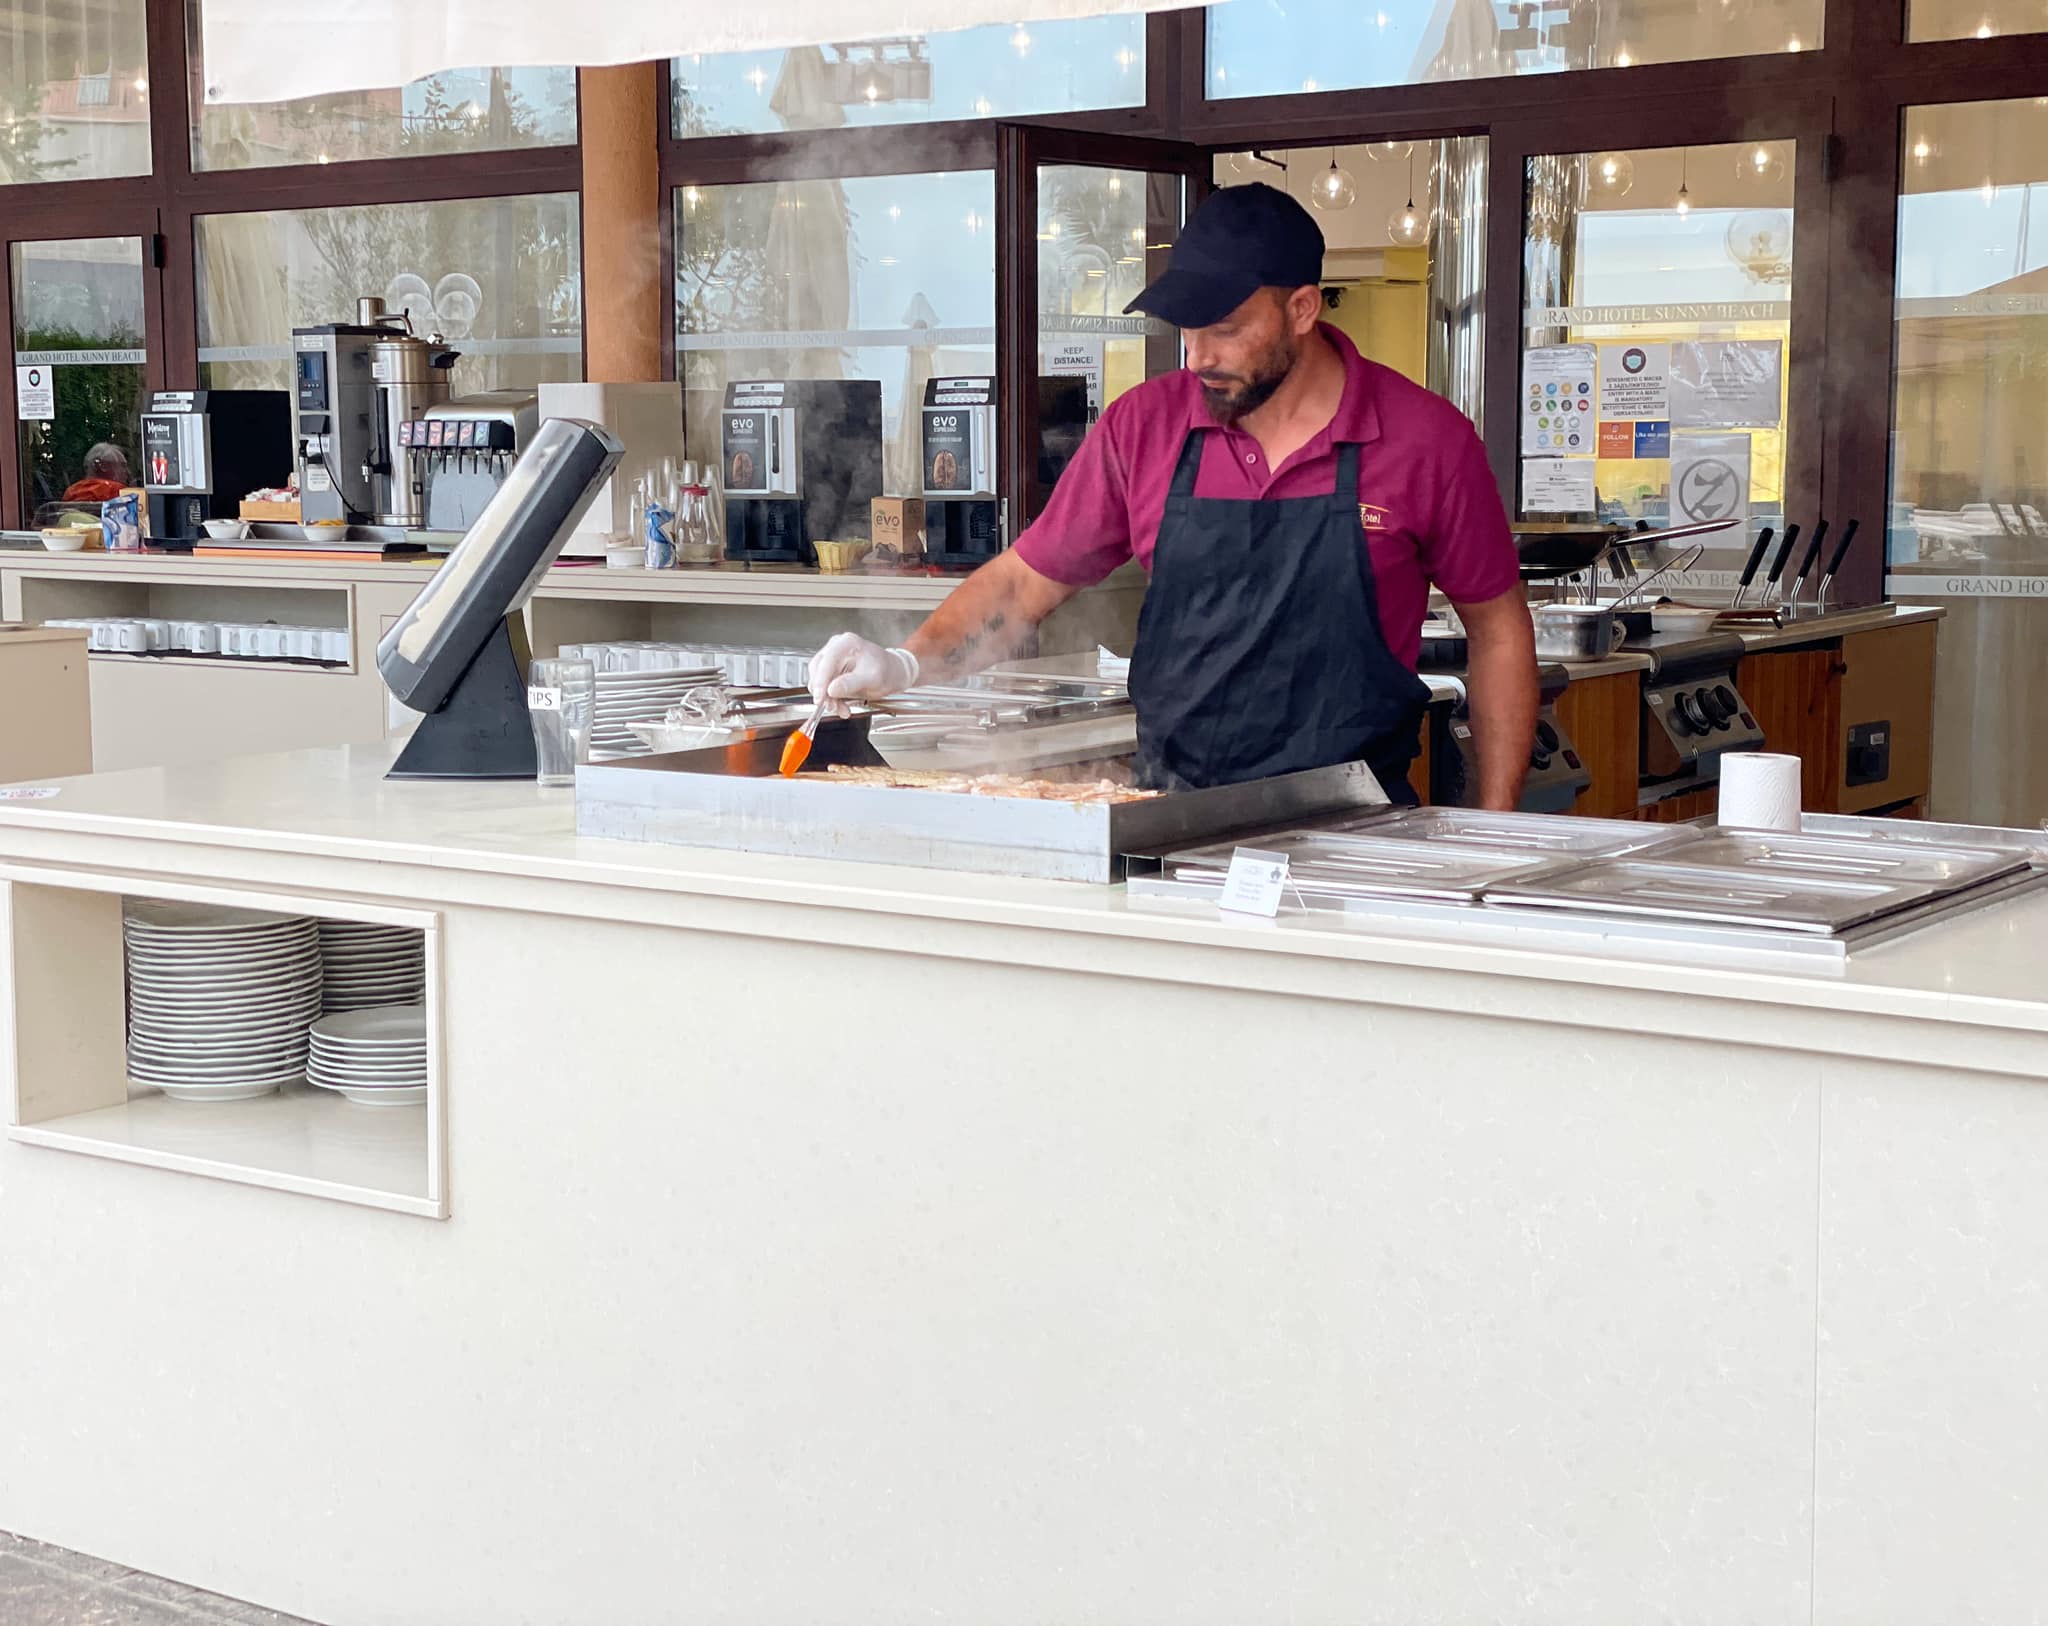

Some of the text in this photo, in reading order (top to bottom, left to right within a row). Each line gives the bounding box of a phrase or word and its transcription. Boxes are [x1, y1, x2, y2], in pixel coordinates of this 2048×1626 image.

[1599, 307, 1650, 321] HOTEL
[1655, 305, 1711, 320] SUNNY
[1717, 303, 1774, 318] BEACH
[1064, 346, 1084, 355] KEEP
[22, 351, 141, 362] GRAND HOTEL SUNNY BEACH
[731, 419, 754, 429] evo
[932, 416, 957, 426] evo
[876, 515, 900, 526] evo
[1710, 574, 1767, 588] BEAH
[1946, 579, 2048, 593] GRAND HO
